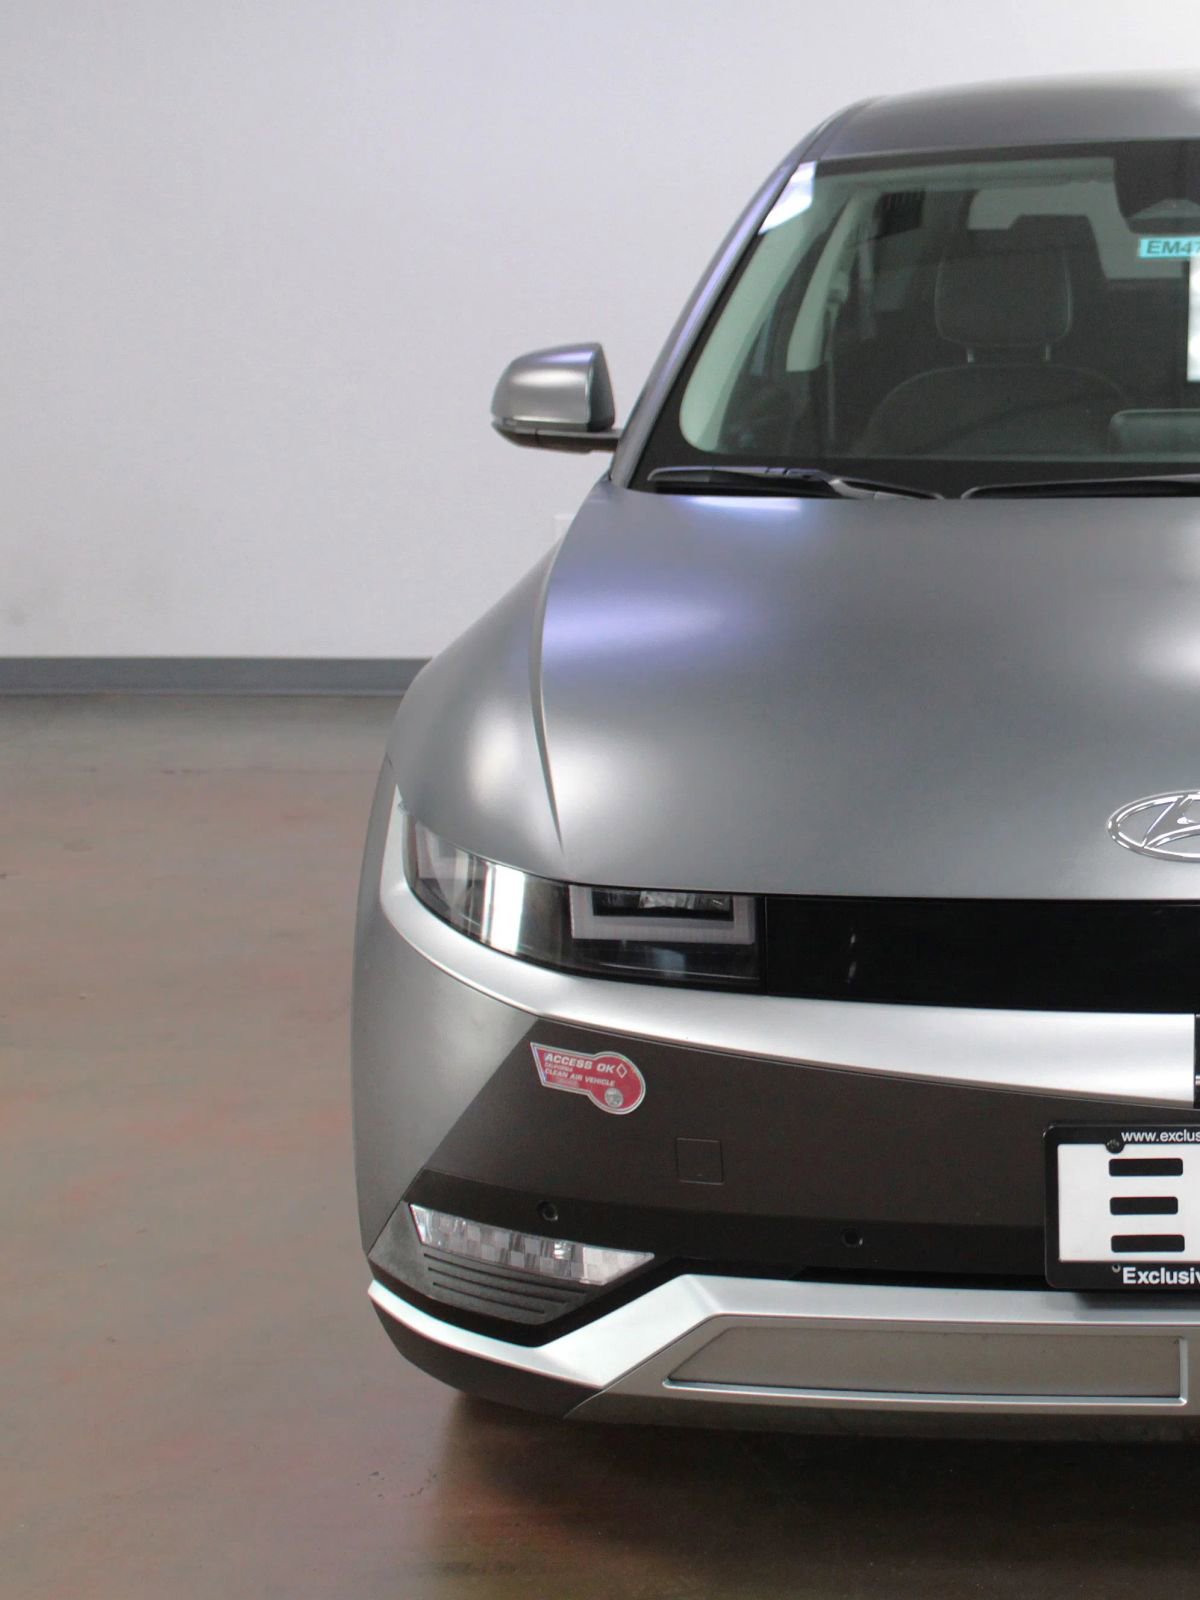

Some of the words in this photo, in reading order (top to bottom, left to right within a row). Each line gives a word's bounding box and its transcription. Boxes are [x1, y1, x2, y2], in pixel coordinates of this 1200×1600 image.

[545, 1053, 593, 1070] ACCESS
[596, 1063, 616, 1074] OK
[544, 1068, 569, 1079] CLEAN
[570, 1073, 583, 1081] AIR
[584, 1076, 616, 1087] VEHICLE
